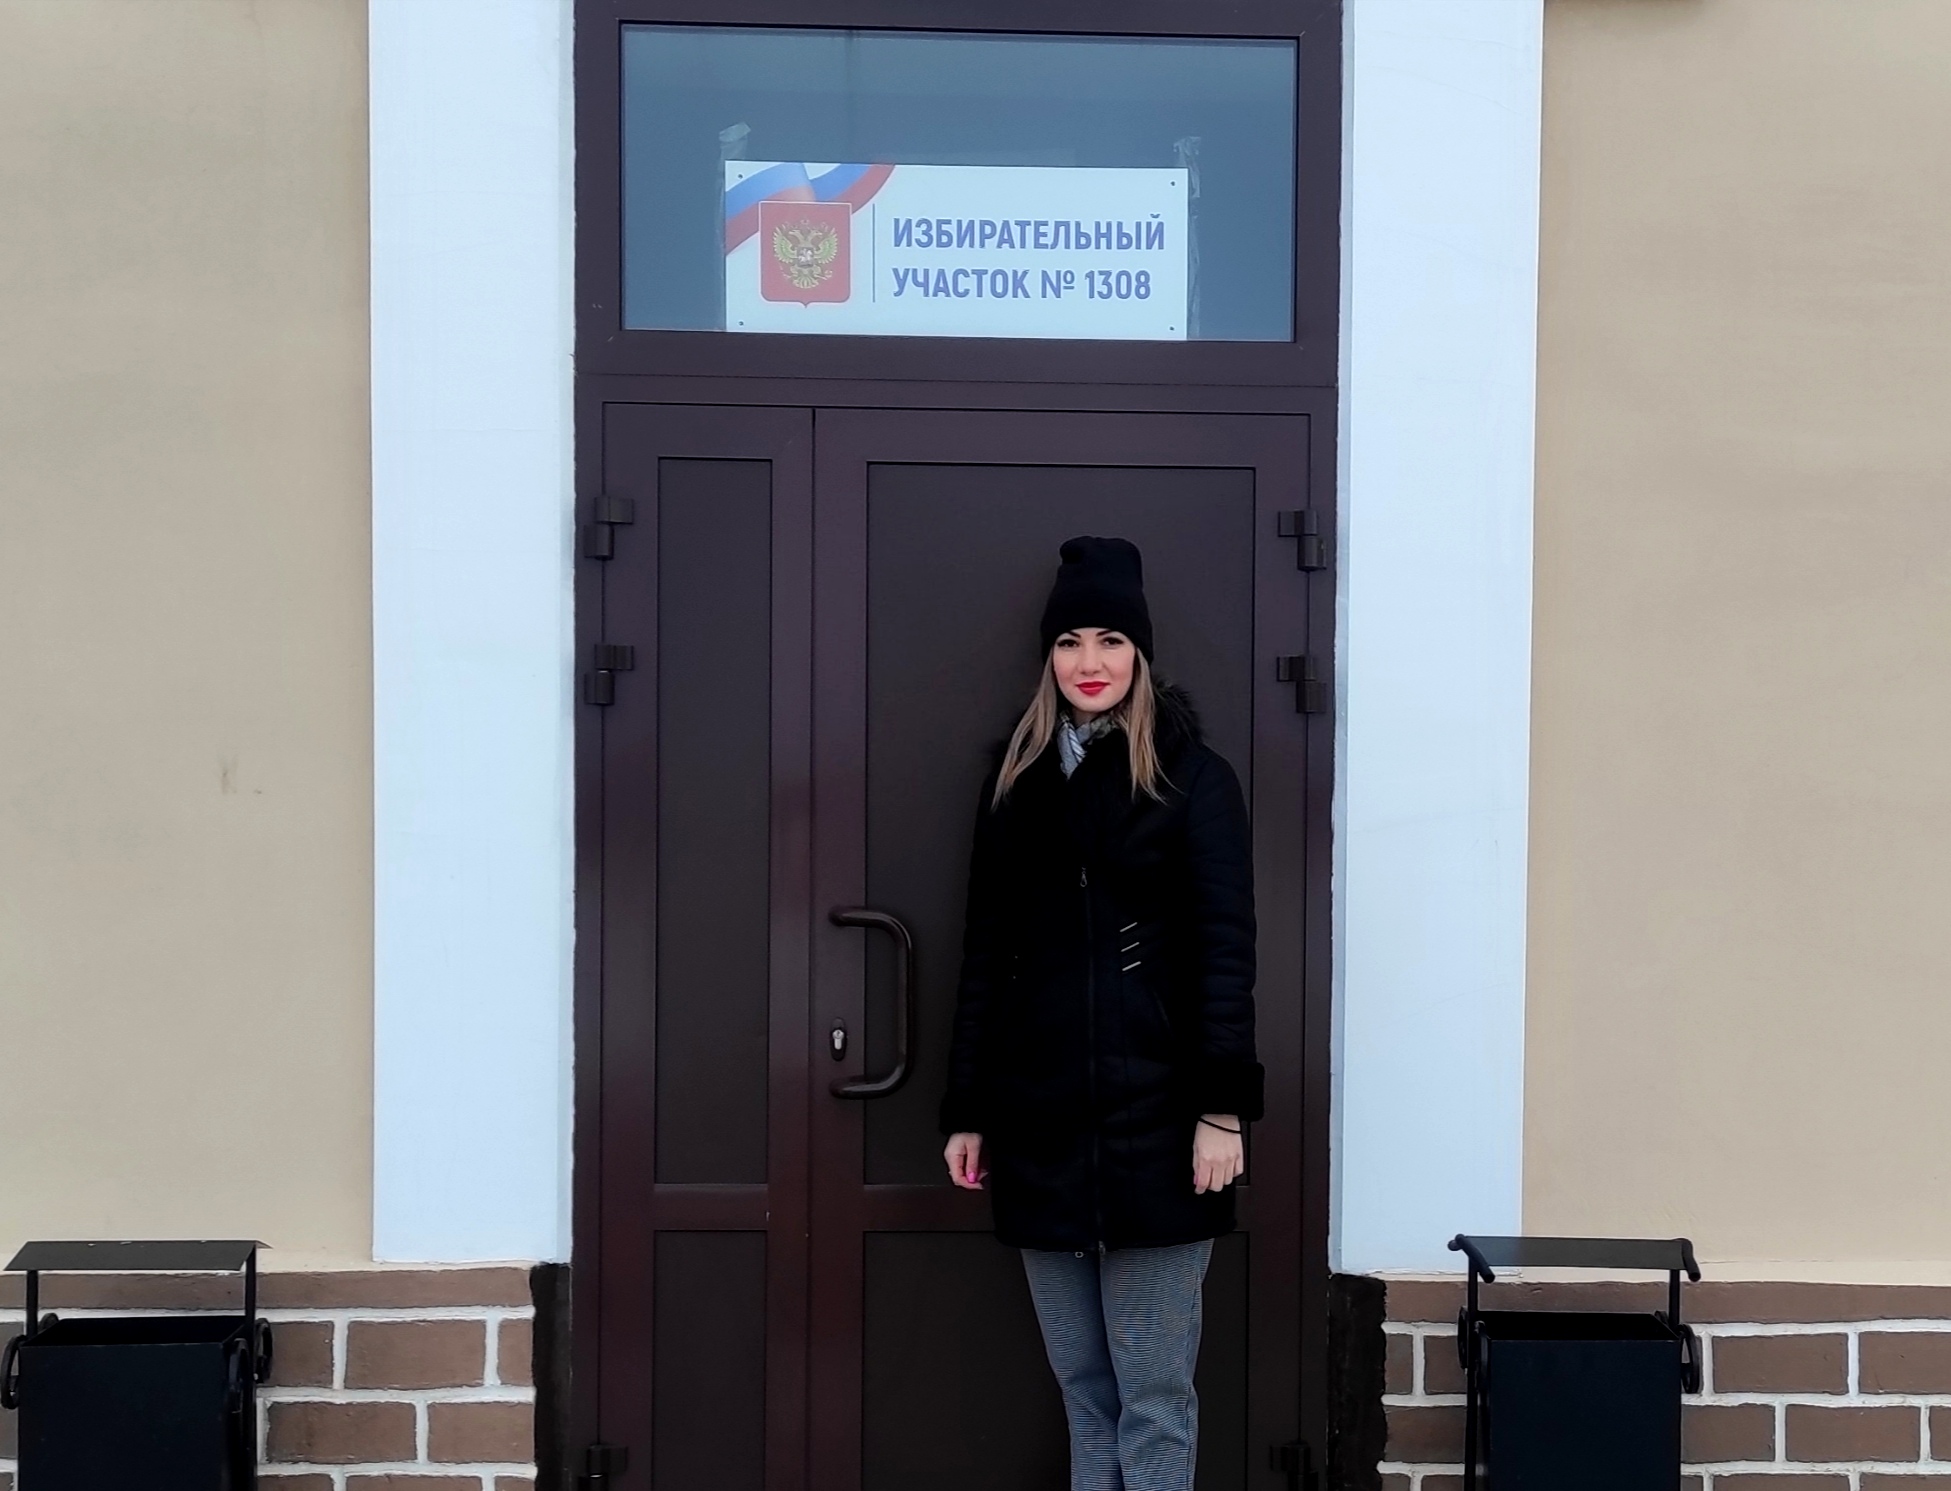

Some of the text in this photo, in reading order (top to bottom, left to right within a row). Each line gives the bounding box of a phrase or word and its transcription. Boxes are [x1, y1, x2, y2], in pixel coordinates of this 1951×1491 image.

[893, 213, 1165, 250] ИЗБИРАТЕЛЬНЫЙ
[892, 267, 1151, 300] УЧАСТОК № 1308
